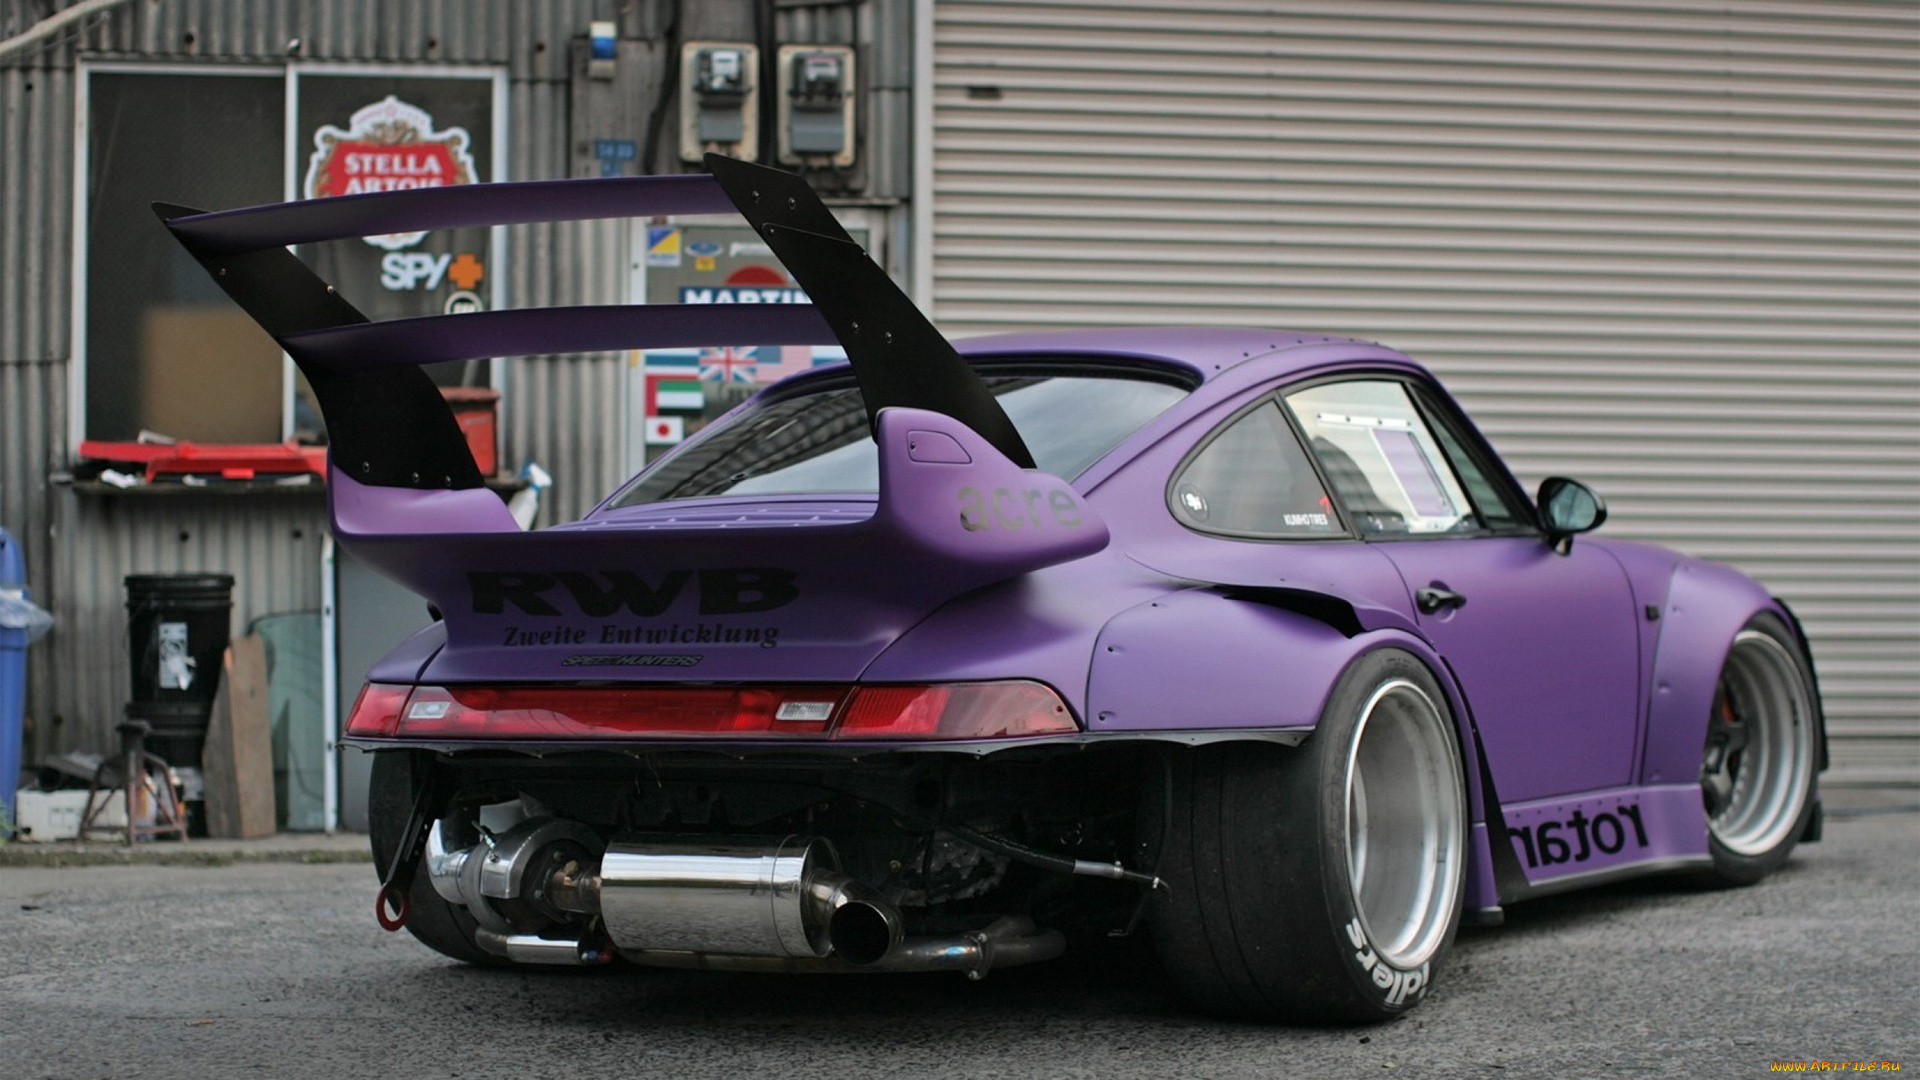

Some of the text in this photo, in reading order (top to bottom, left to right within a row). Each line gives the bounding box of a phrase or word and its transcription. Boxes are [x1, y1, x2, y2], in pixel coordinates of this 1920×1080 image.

[345, 153, 442, 175] STELLA
[958, 486, 1082, 532] acre
[467, 566, 800, 618] RWB
[503, 623, 780, 649] Zweite Entwicklung
